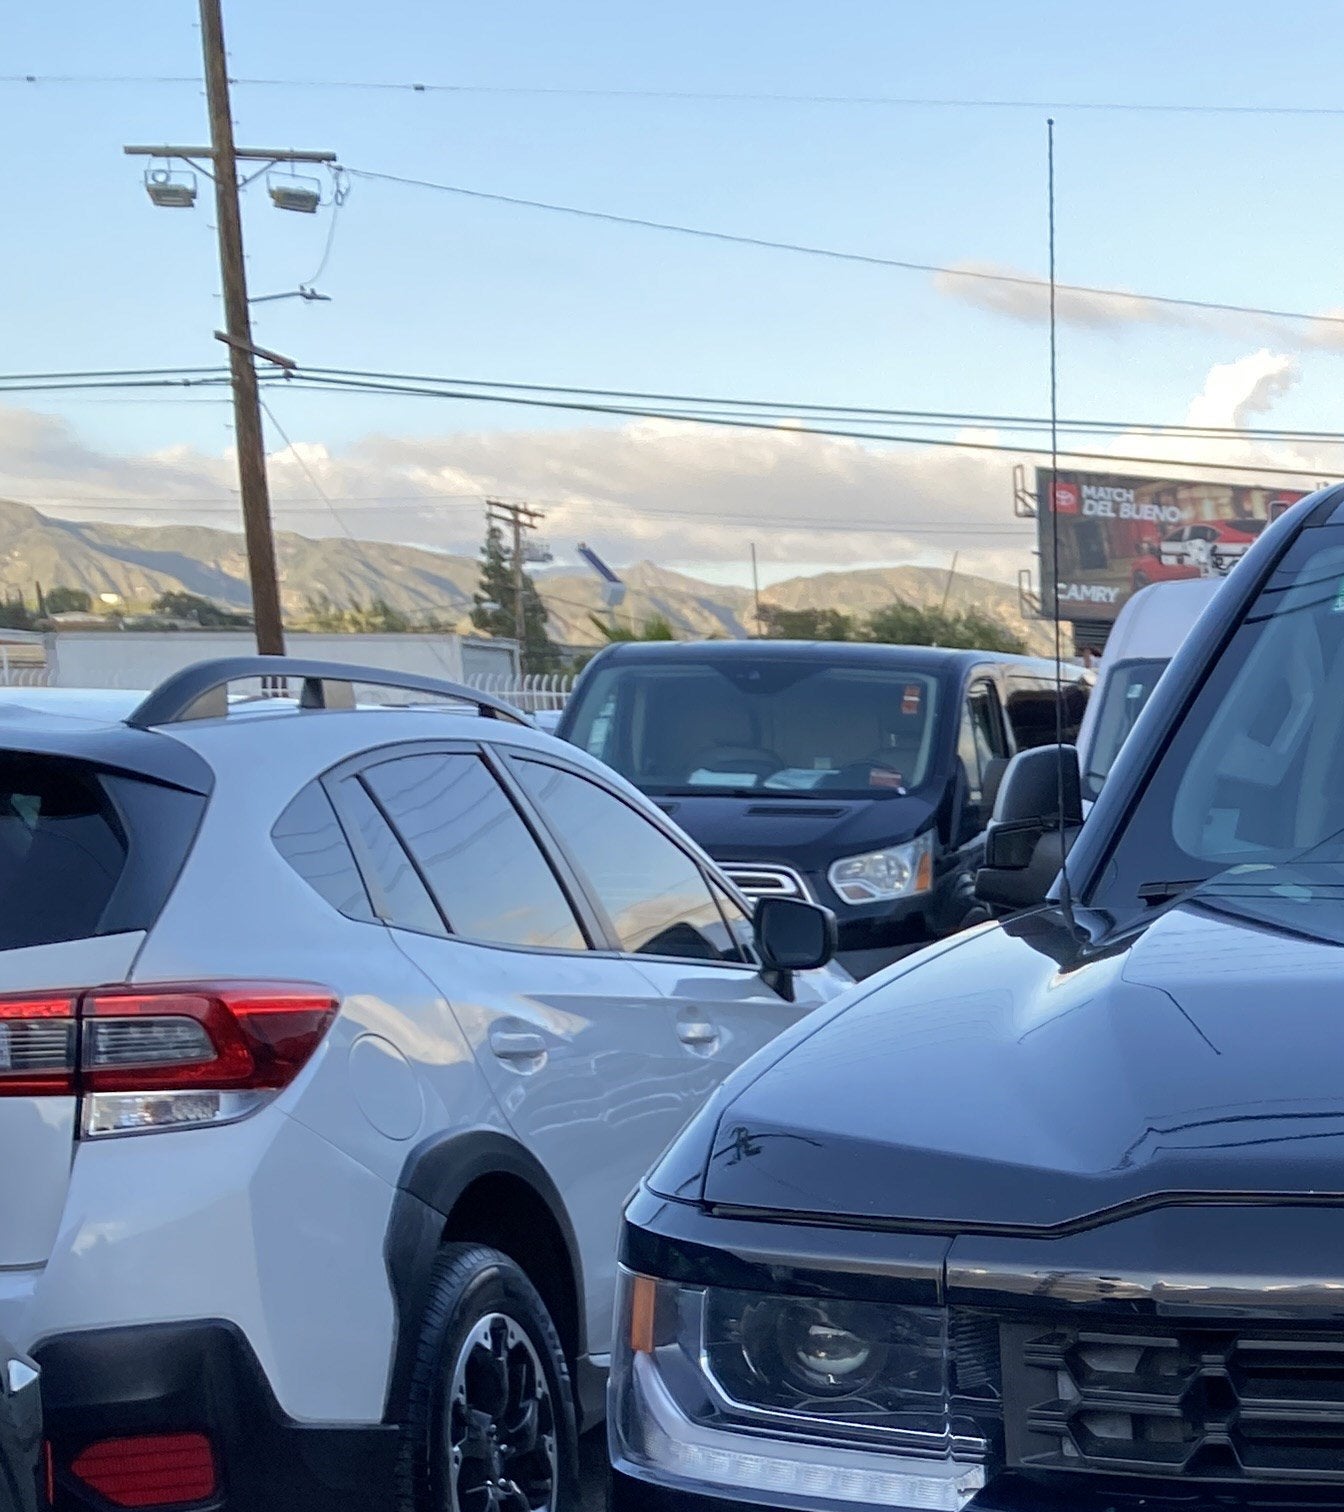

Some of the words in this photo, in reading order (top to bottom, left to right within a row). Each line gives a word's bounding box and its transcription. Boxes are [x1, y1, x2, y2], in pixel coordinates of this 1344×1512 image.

[1081, 484, 1134, 502] MATCH
[1081, 499, 1117, 518] DEL
[1119, 503, 1181, 522] BUENO
[1053, 582, 1120, 603] CAMRY
